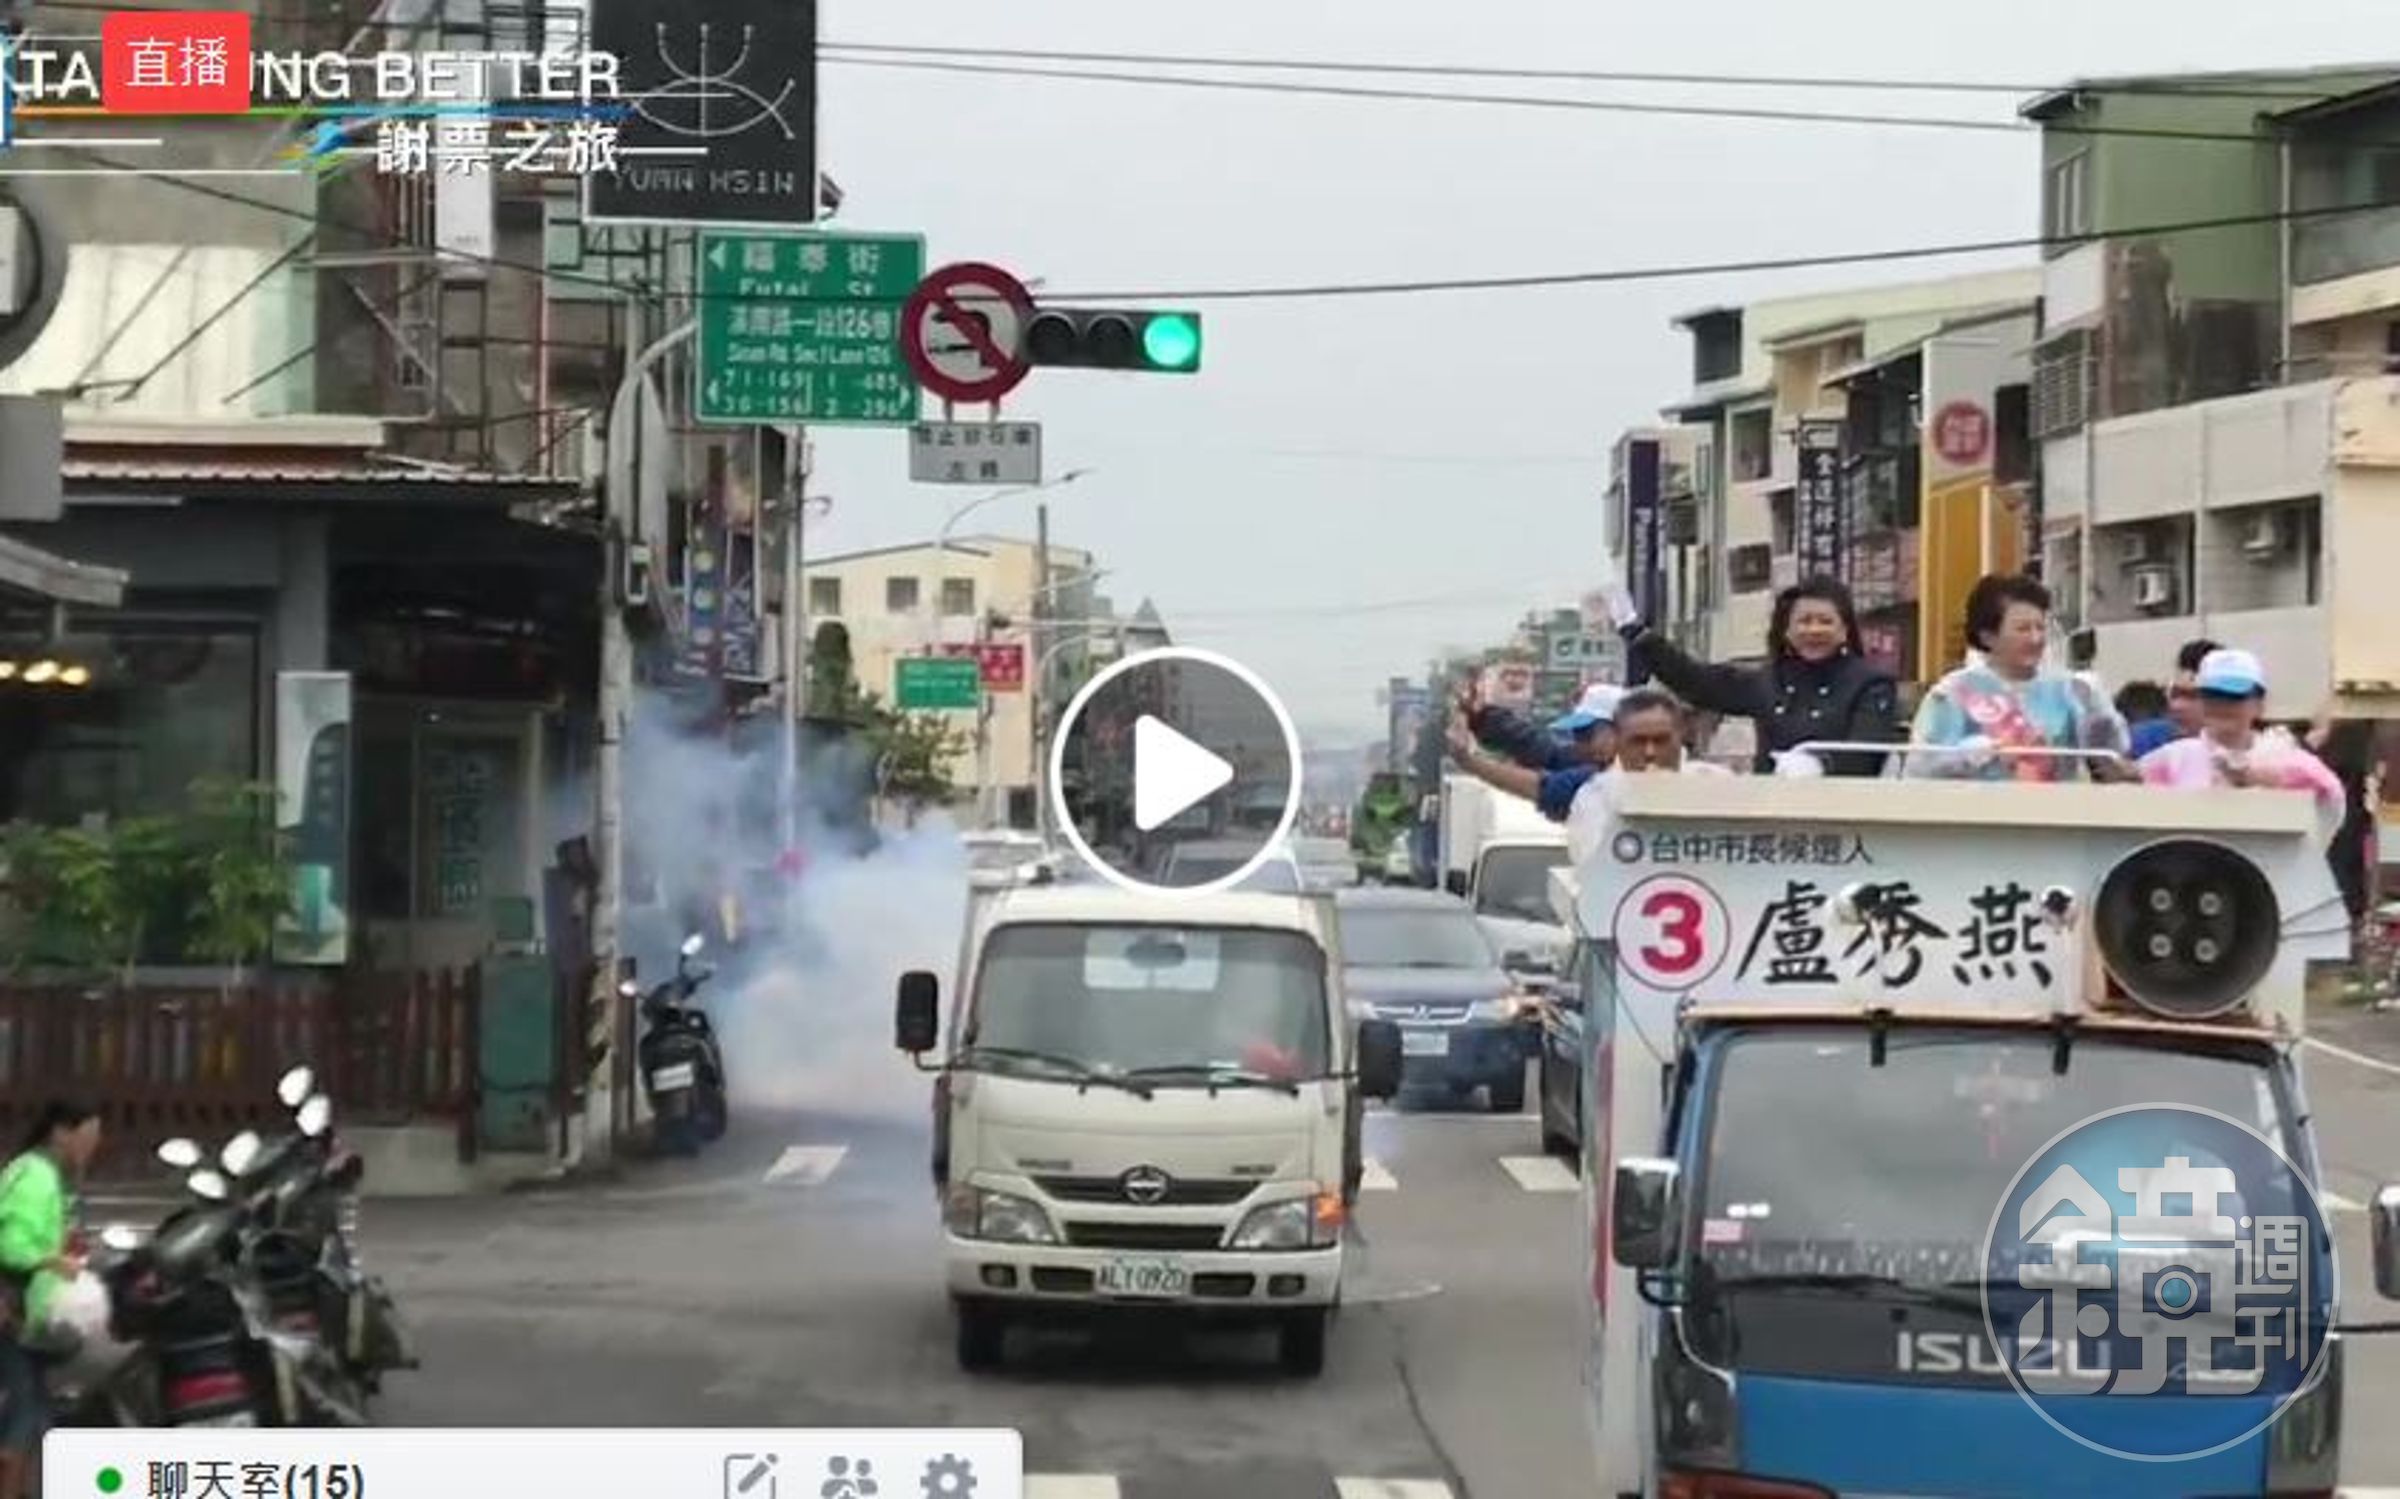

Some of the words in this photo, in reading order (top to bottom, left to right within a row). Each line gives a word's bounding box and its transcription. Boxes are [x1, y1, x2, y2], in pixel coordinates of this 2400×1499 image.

[709, 169, 793, 194] HSIN
[1652, 833, 1873, 864] 台中市長候選人
[1641, 890, 1703, 974] 3
[1735, 878, 2053, 988] 盧秀燕
[1897, 1332, 2111, 1378] ISUZU
